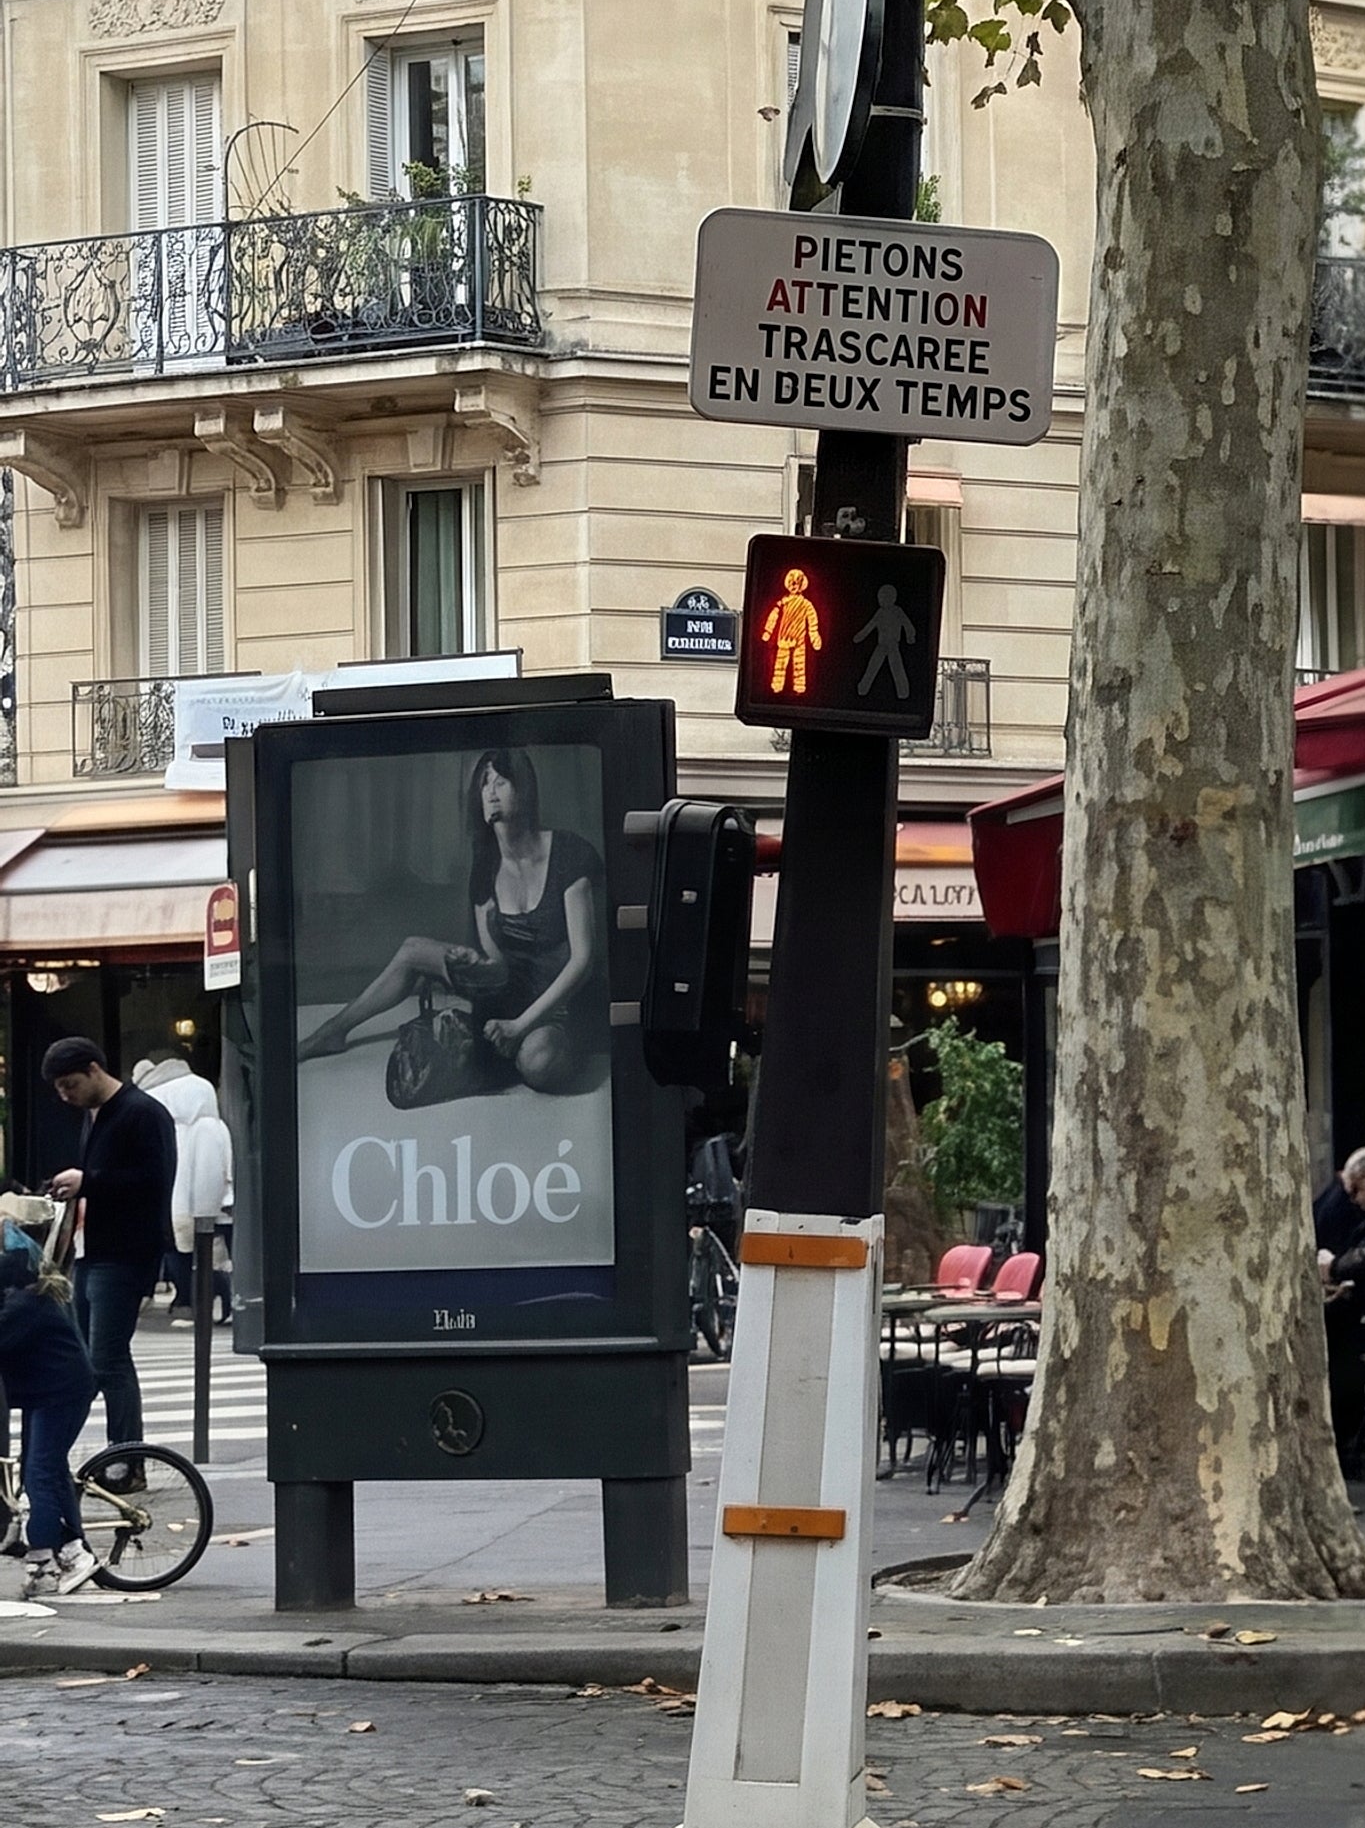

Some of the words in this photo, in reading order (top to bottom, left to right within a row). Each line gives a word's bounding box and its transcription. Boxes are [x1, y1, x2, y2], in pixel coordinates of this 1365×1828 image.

[794, 234, 963, 282] PIETONS
[766, 278, 987, 328] ATTENTION
[758, 323, 990, 375] TRASCAREE
[708, 365, 760, 402] EN
[774, 371, 881, 412] DEUX
[895, 379, 1031, 423] TEMPS
[331, 1135, 582, 1229] Chloé
